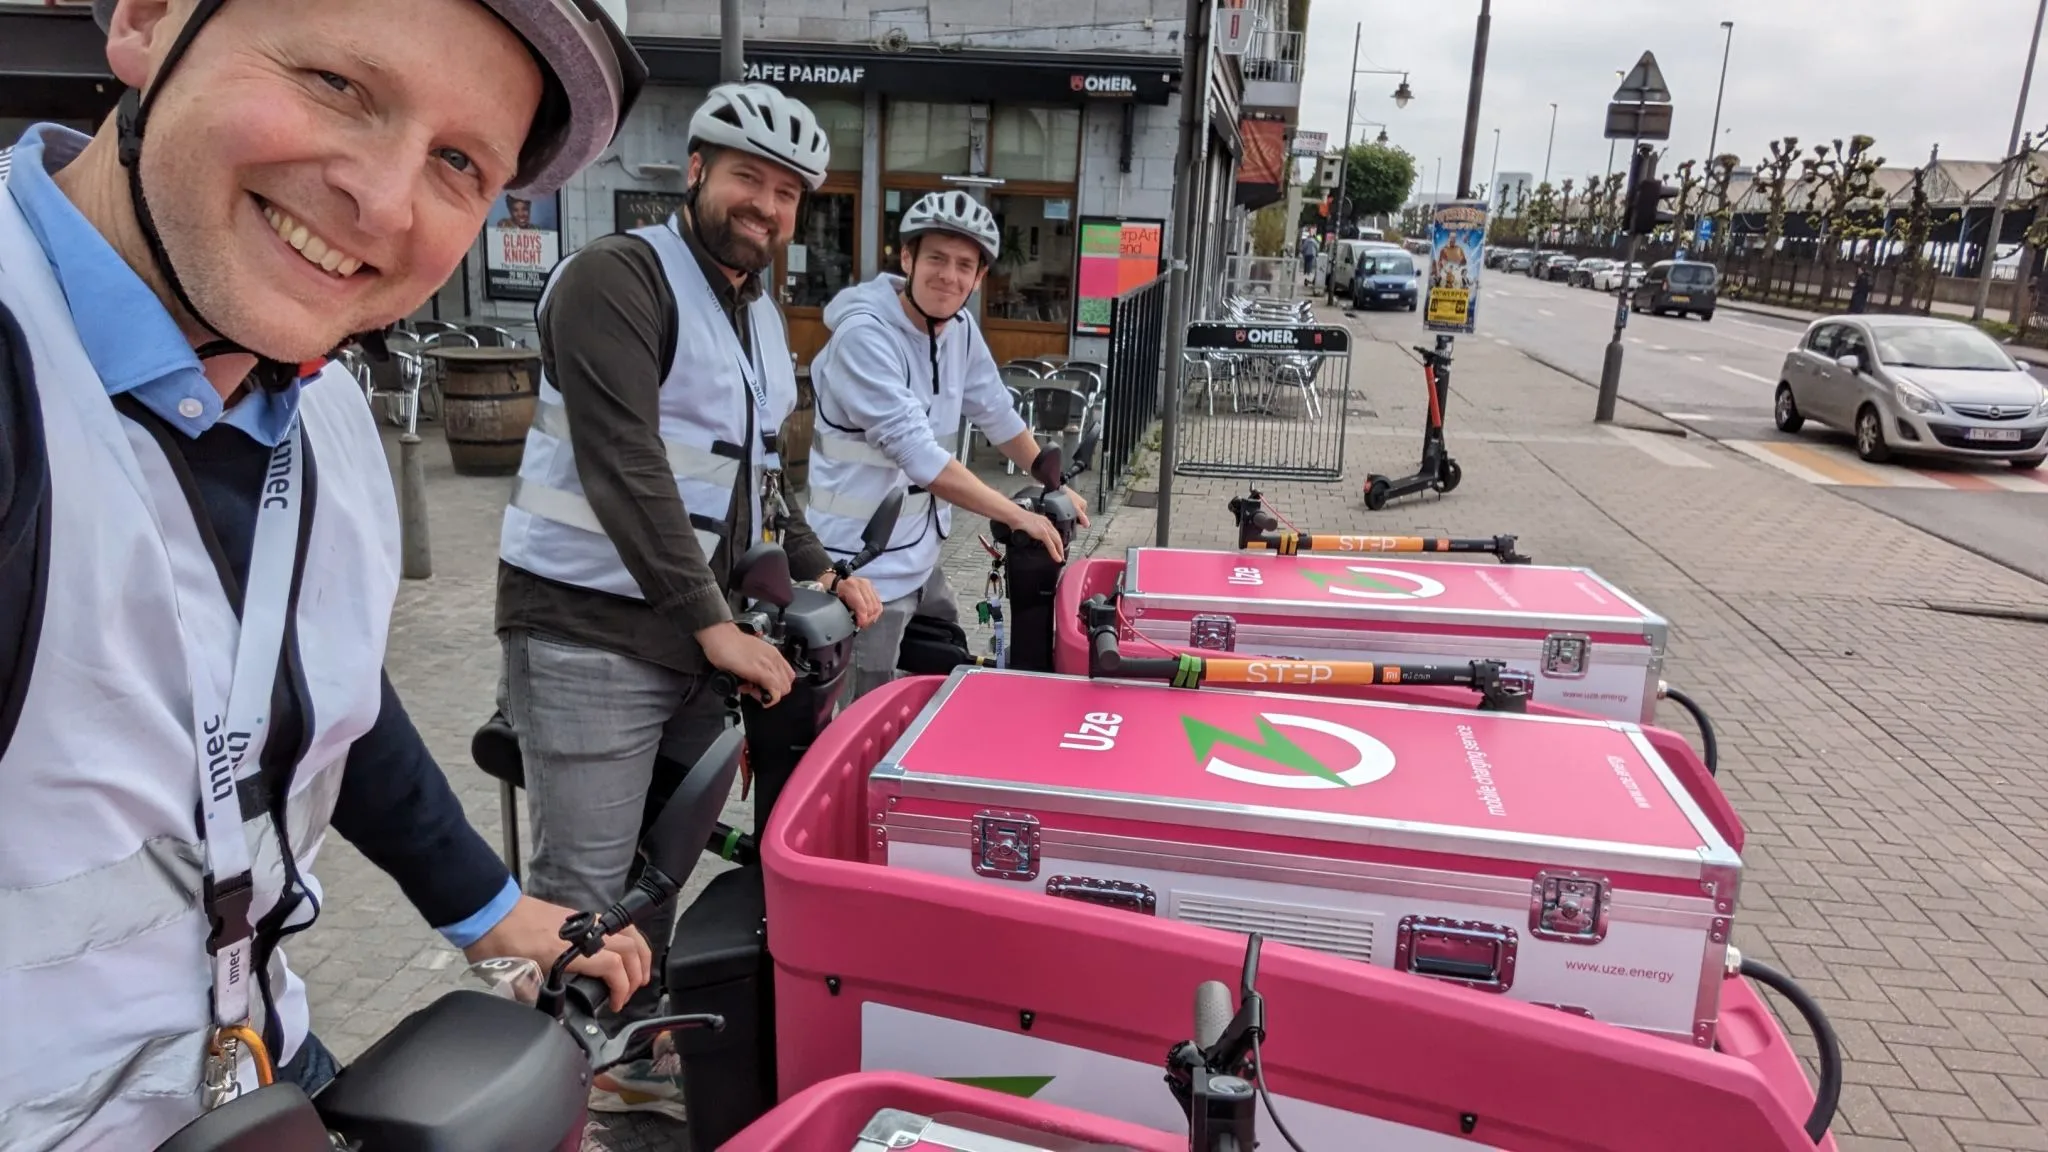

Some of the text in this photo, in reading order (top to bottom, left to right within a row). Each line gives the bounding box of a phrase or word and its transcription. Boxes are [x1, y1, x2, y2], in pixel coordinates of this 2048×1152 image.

[789, 65, 865, 83] PARDAF
[1084, 75, 1137, 92] OMER.
[503, 233, 542, 250] GLADYS
[504, 247, 542, 264] KNIGHT
[1432, 290, 1469, 298] ANTWERPEN
[1248, 329, 1299, 344] OMER.
[751, 379, 767, 407] imec
[1339, 536, 1397, 551] STEP
[1228, 567, 1264, 585] Uze
[1246, 662, 1333, 684] STEP
[1059, 712, 1123, 751] Uze
[203, 713, 233, 806] imec
[1456, 725, 1507, 816] mobile charging service
[229, 948, 240, 986] imec
[1565, 960, 1675, 984] www.uze.energy
